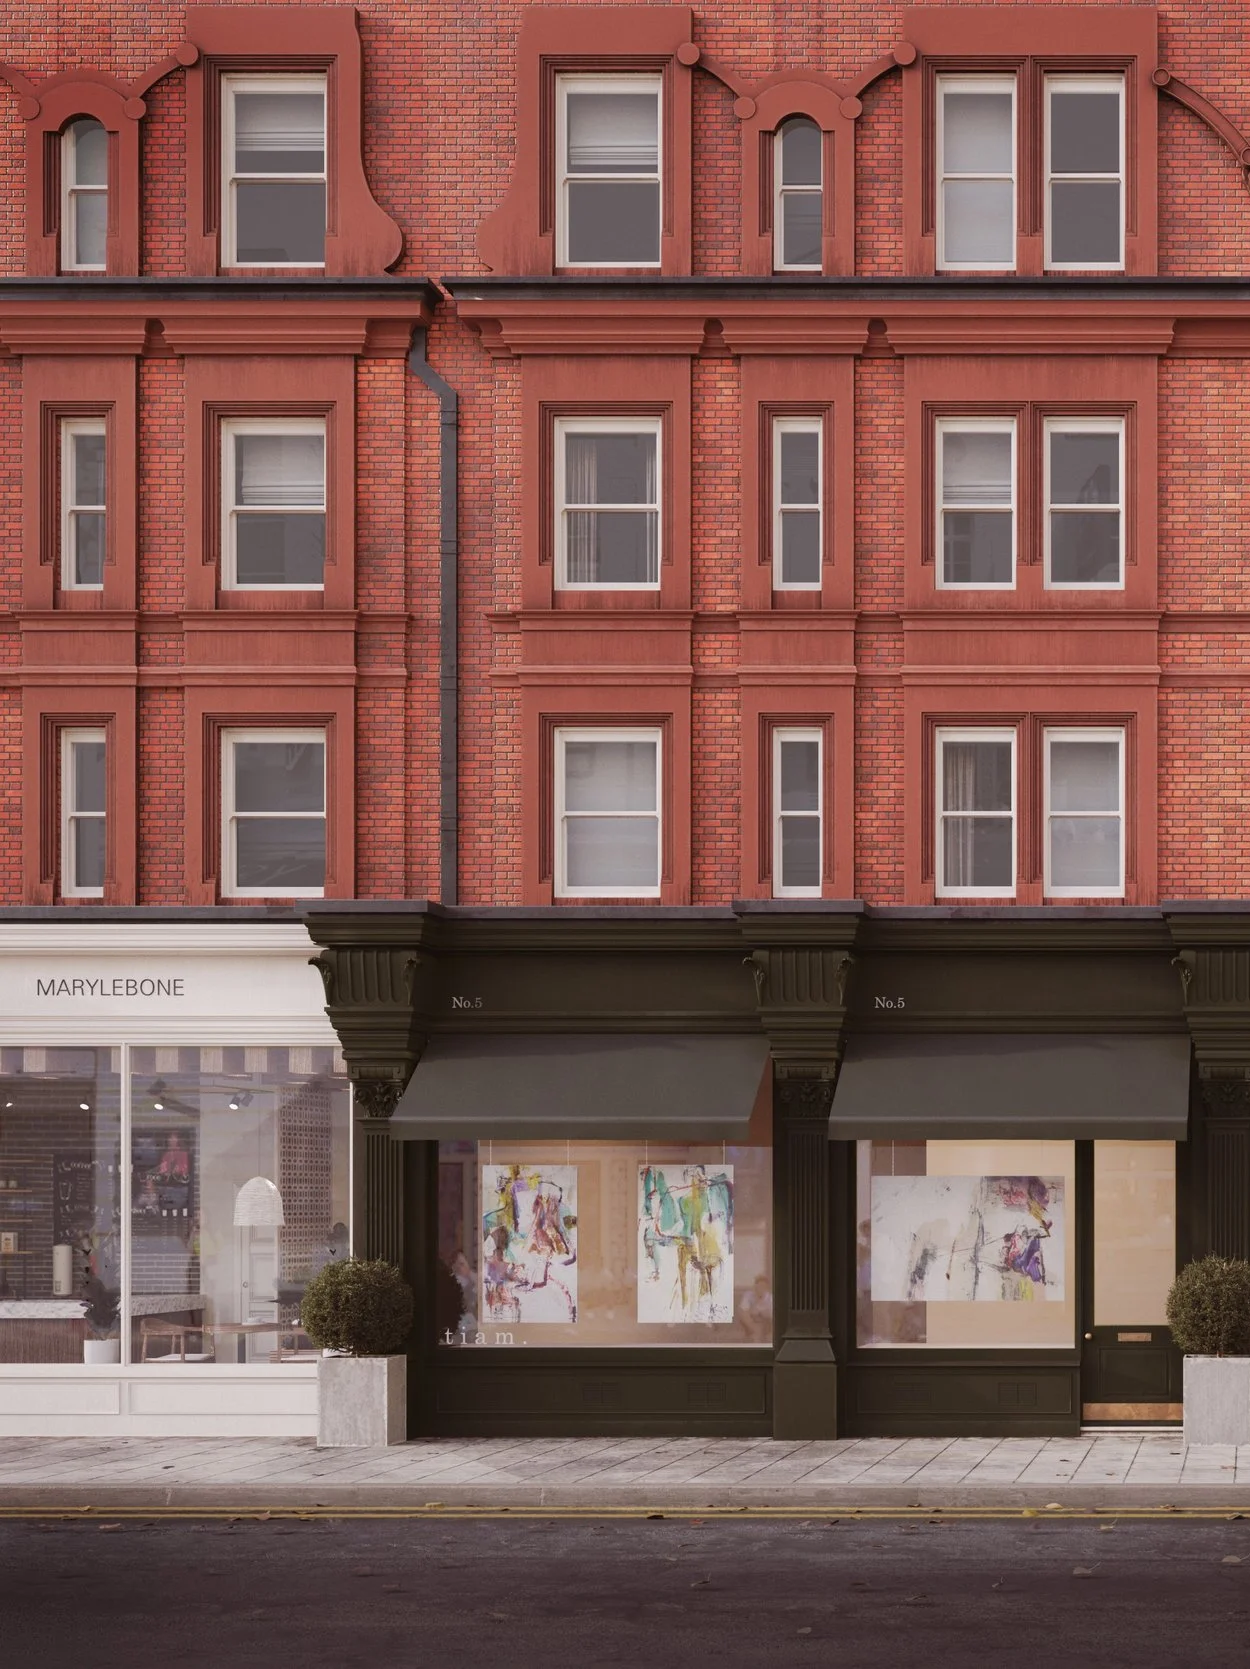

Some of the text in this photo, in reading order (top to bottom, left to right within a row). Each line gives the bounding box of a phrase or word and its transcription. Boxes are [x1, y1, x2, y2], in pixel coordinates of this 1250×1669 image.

[37, 979, 184, 996] MARYLEBONE
[451, 996, 483, 1009] No.5
[874, 996, 906, 1009] No.5
